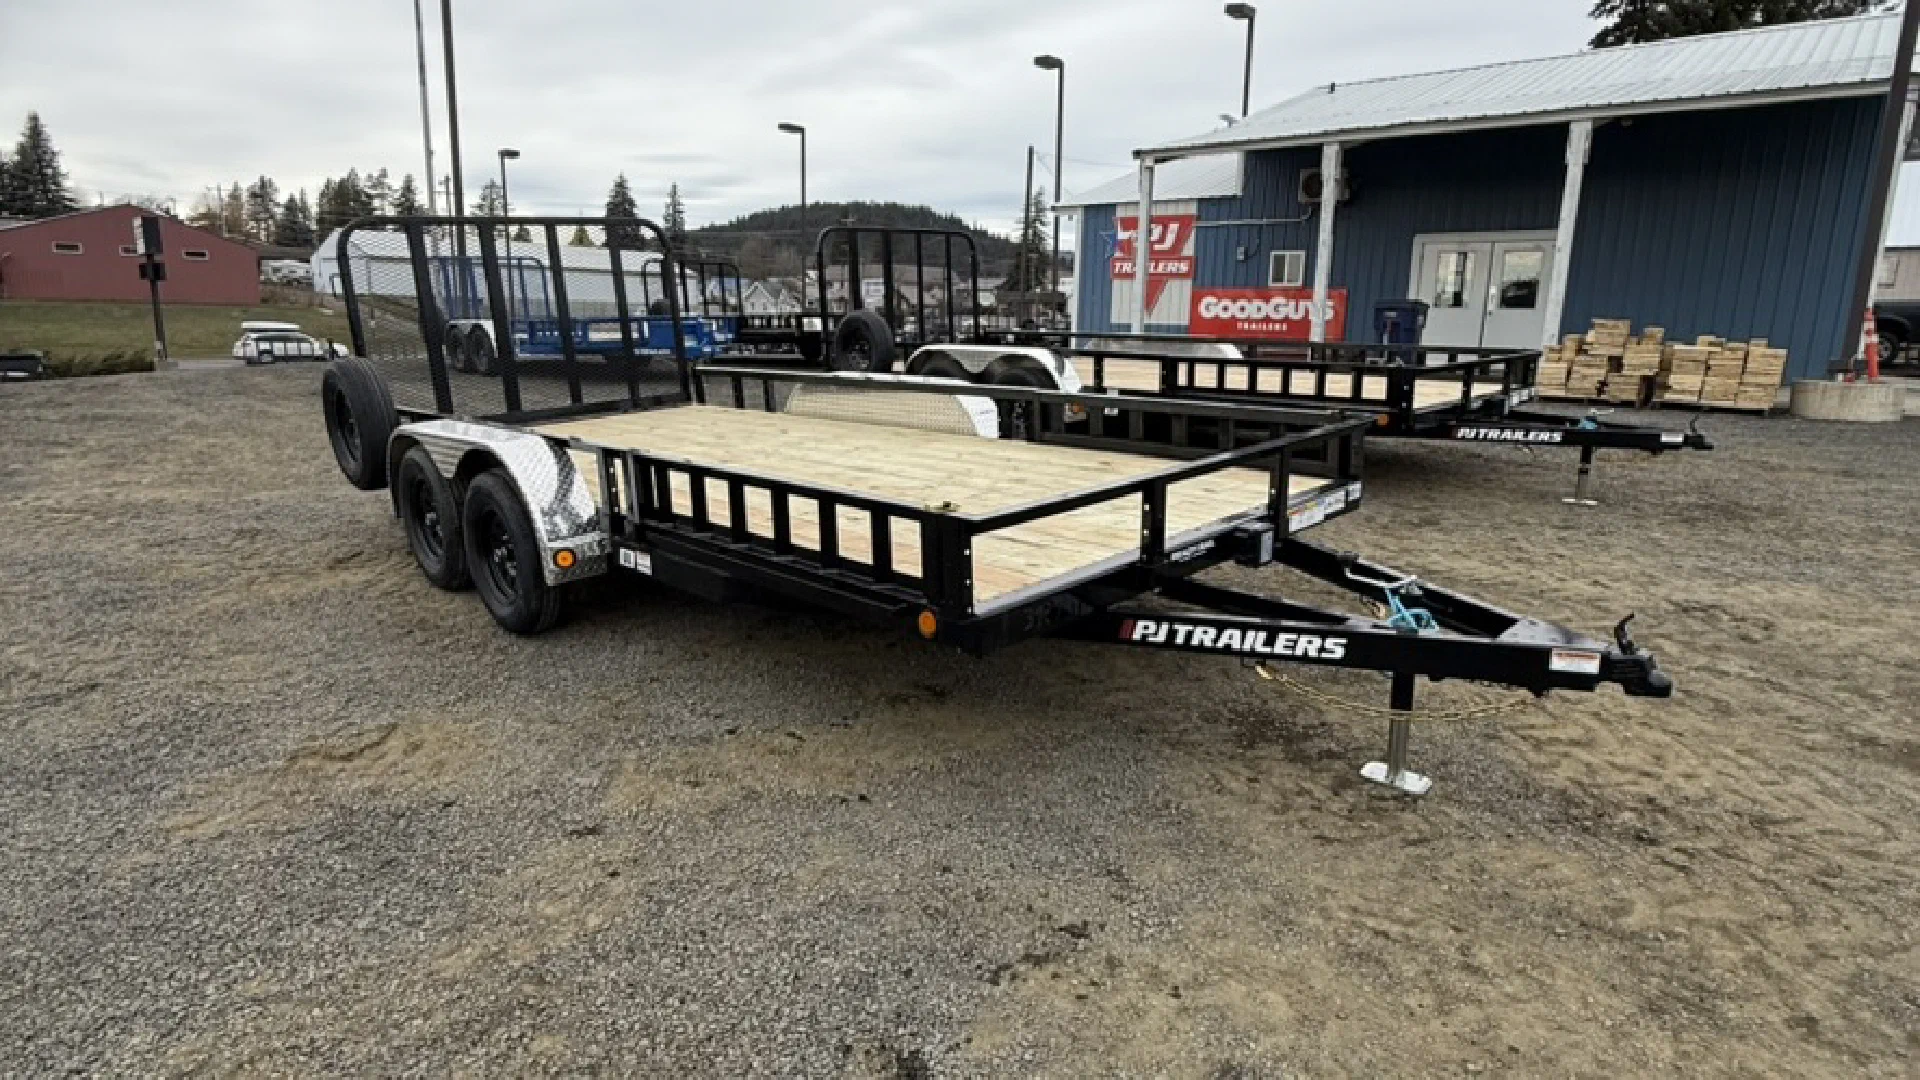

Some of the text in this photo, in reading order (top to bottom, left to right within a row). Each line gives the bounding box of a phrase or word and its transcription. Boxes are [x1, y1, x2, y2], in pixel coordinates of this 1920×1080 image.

[1113, 261, 1190, 274] TRILERS
[1132, 619, 1349, 659] PJ TRAILERS
